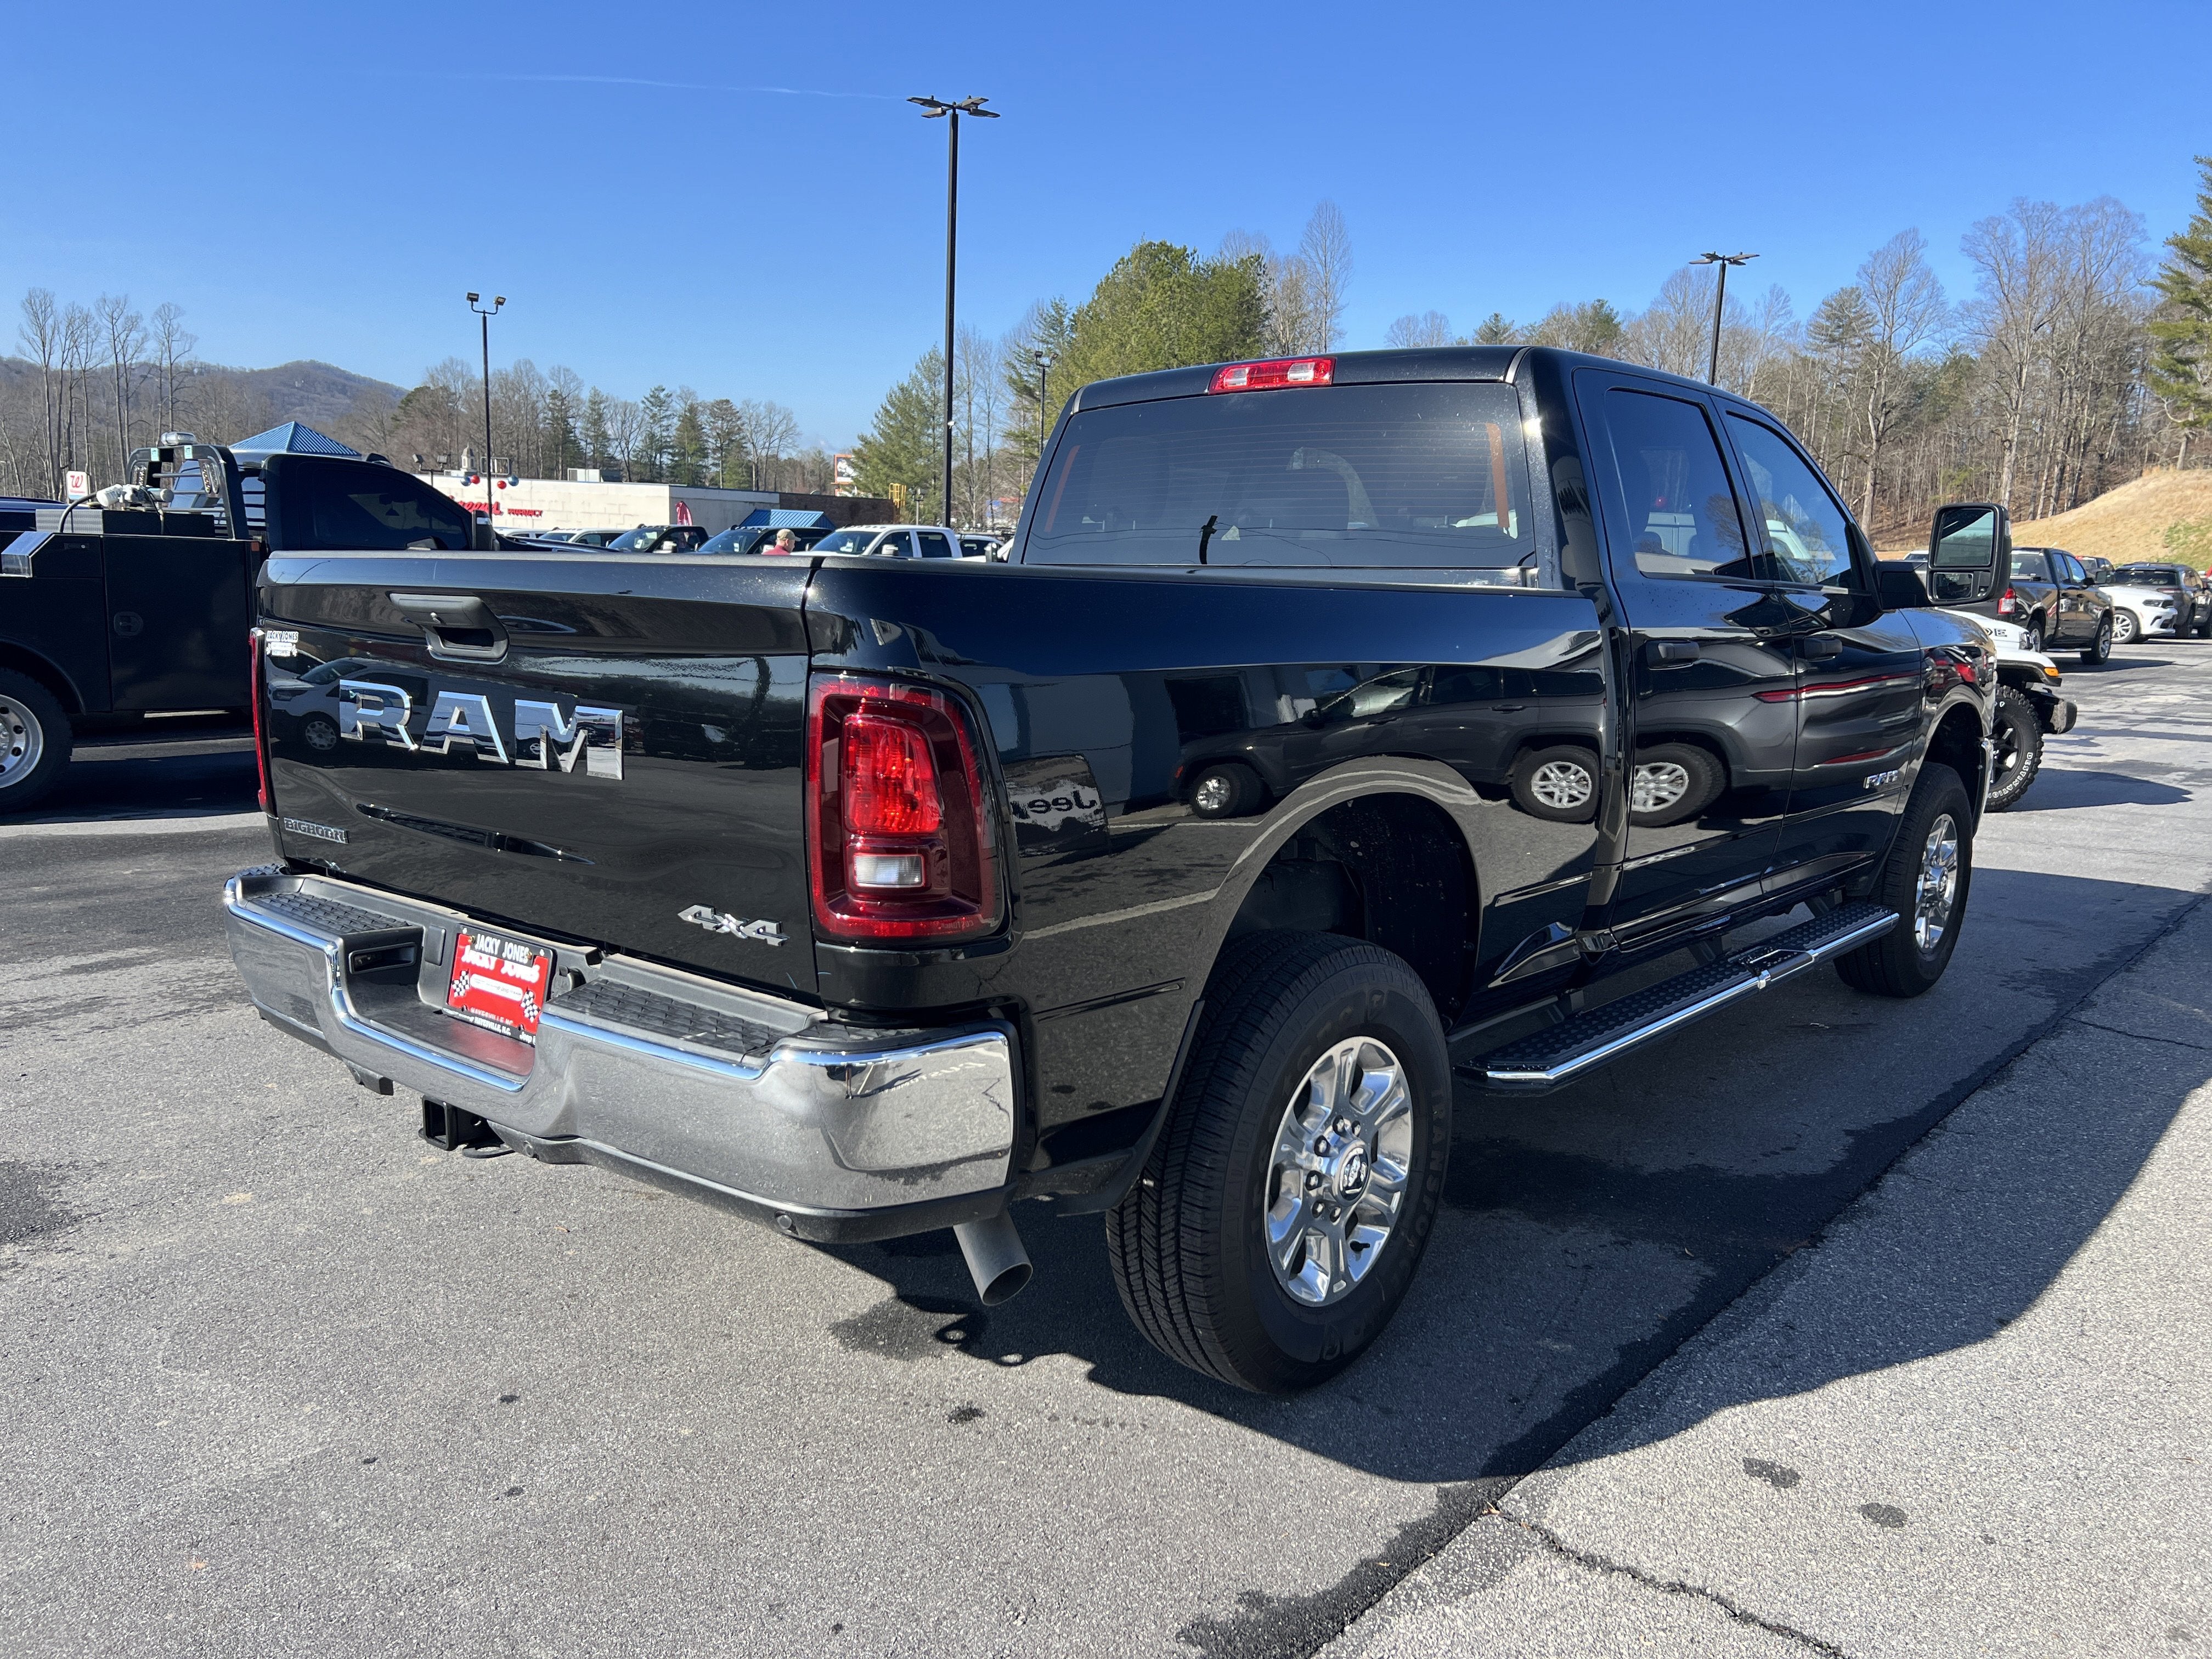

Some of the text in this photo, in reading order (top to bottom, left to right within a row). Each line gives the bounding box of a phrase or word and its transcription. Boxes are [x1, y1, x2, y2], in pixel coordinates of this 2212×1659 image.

[267, 631, 298, 641] JACKY JONES
[339, 679, 624, 781] RAM
[475, 934, 531, 964] JACKY JONES
